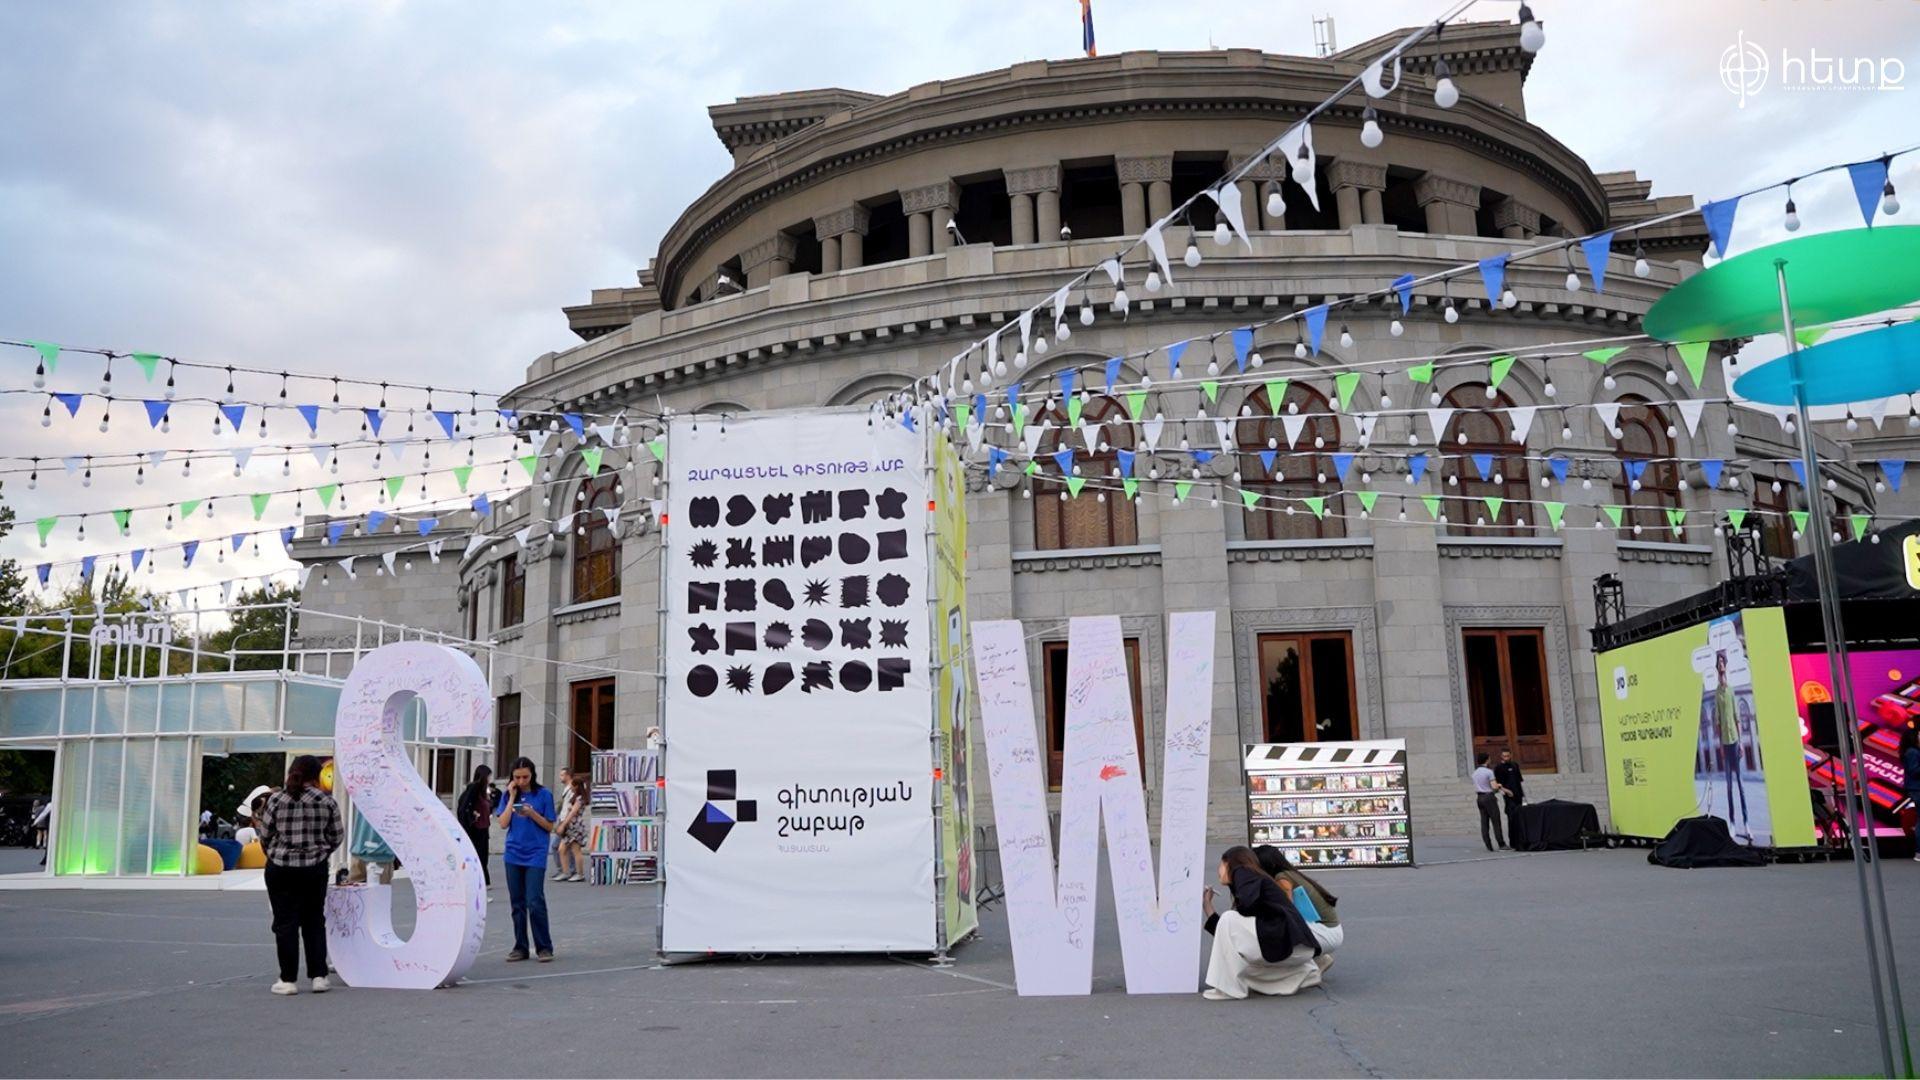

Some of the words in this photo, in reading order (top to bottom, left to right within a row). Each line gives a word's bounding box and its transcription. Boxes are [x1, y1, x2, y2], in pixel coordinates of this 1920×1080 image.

[687, 465, 788, 481] ԶԱՐԳԱՑՆԵԼ
[793, 458, 904, 476] ԳԻՏՈՒԹՅՄԲ
[777, 780, 913, 810] գիտության
[777, 815, 865, 838] շաբաթ
